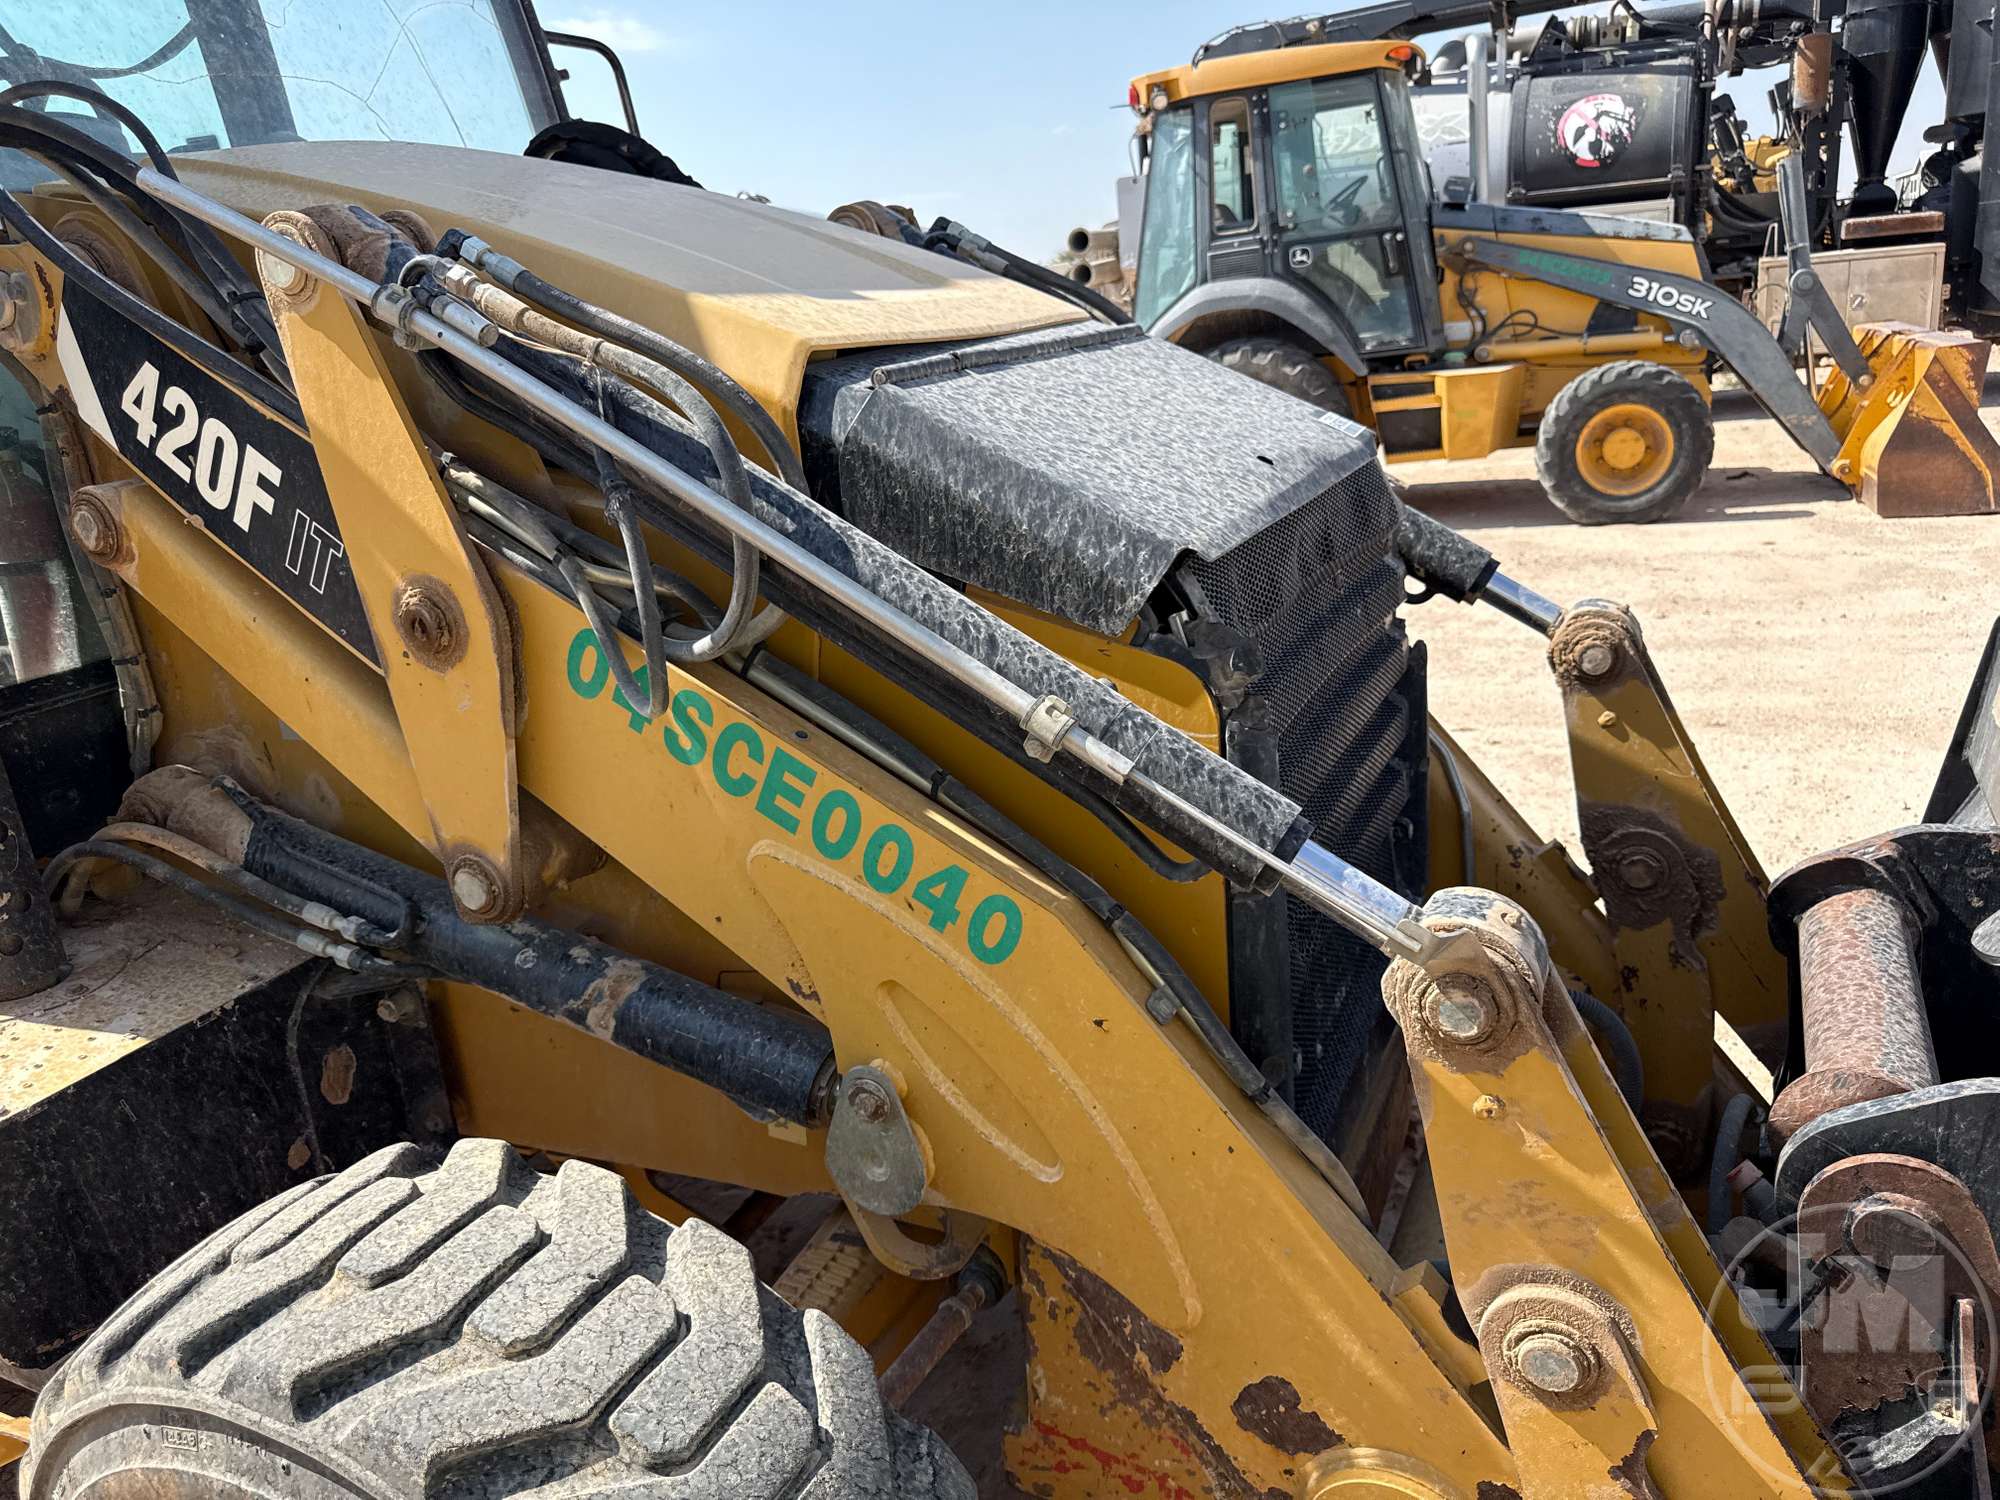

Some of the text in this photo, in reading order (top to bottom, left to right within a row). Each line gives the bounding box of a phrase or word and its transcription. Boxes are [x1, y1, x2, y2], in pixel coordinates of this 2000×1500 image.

[1627, 276, 1714, 319] 310SK
[121, 360, 344, 595] 420F IT
